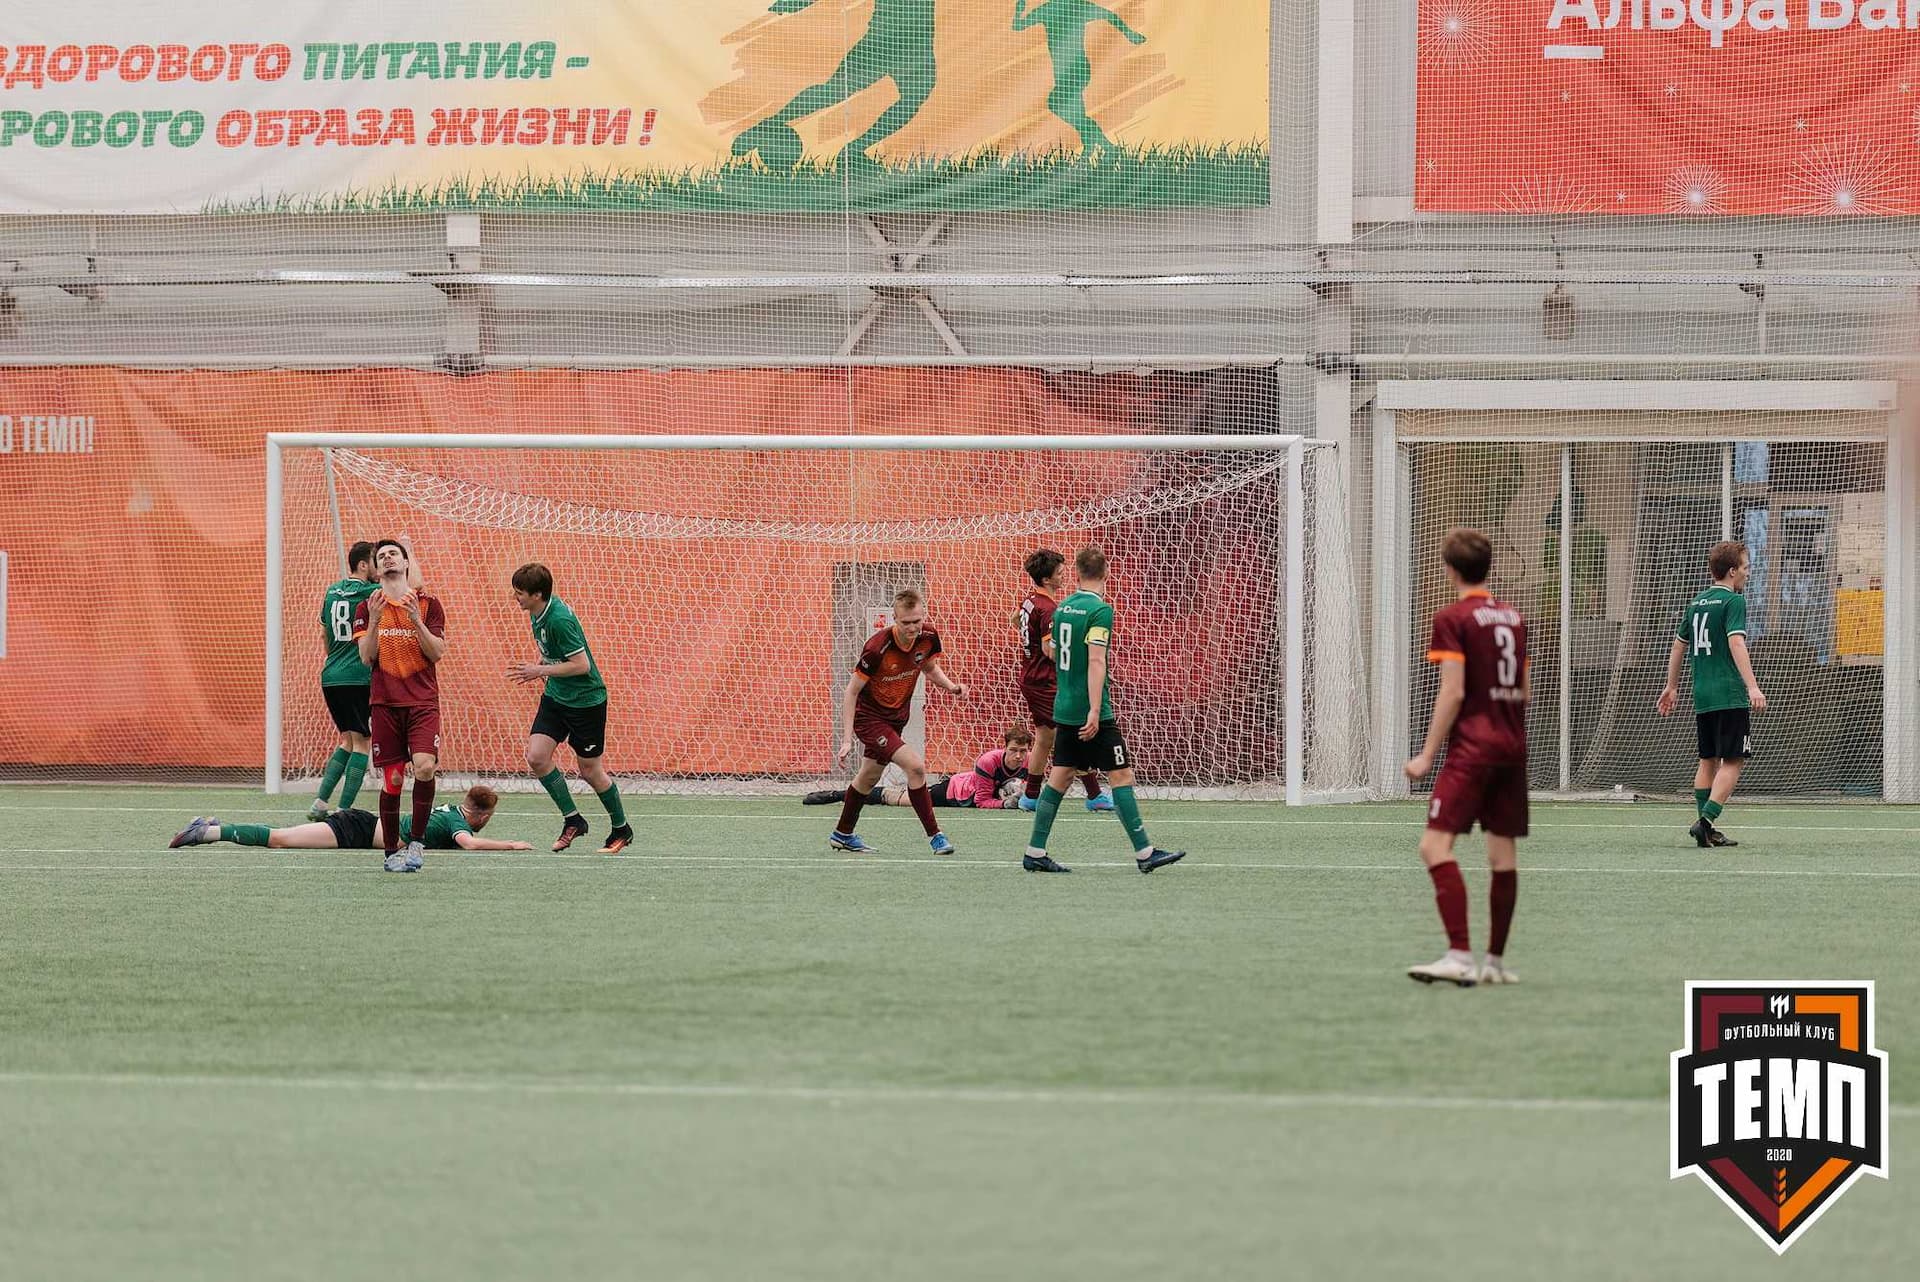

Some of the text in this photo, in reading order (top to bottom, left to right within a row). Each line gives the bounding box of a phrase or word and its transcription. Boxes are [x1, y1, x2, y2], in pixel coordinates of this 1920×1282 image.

[1546, 0, 1788, 48] Альфа
[303, 41, 557, 80] ПИТАНИЯ
[0, 110, 205, 147] РОВОГО
[215, 108, 416, 147] ОБРАЗА
[20, 415, 94, 453] ТЕМП!
[330, 600, 353, 641] 18
[1692, 612, 1712, 656] 14
[1060, 622, 1072, 671] 8
[1494, 625, 1517, 686] 3
[1113, 745, 1125, 766] 8
